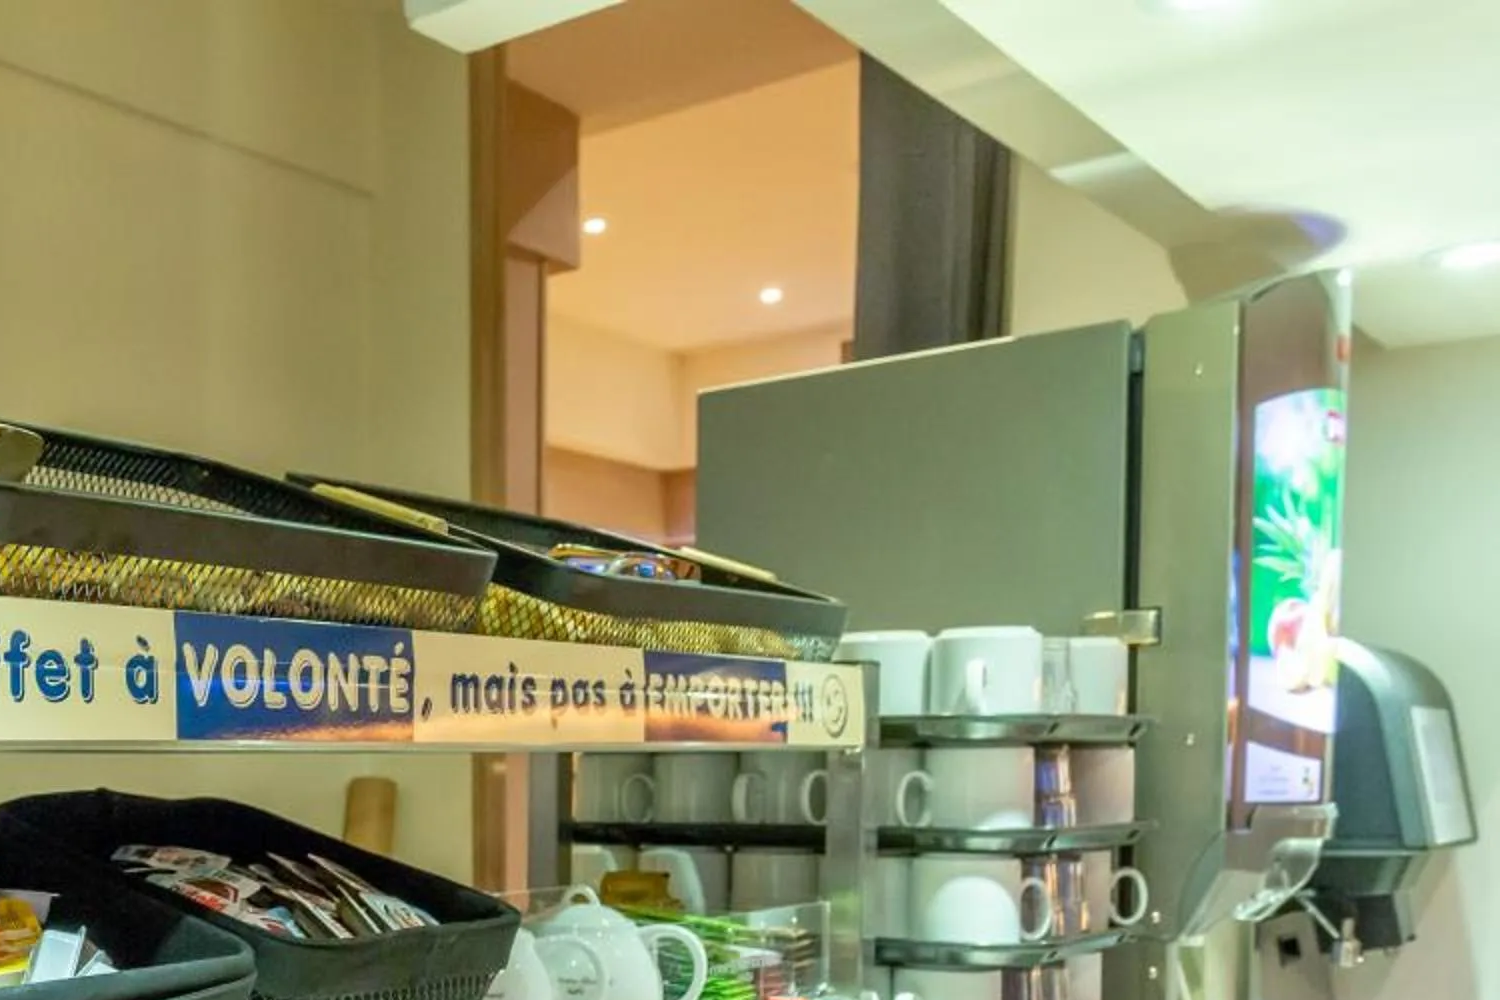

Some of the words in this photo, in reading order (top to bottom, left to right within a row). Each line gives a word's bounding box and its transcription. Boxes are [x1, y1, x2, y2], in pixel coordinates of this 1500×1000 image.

[125, 636, 159, 704] à
[451, 661, 536, 714] mais
[551, 677, 606, 729] pas
[620, 668, 636, 711] à
